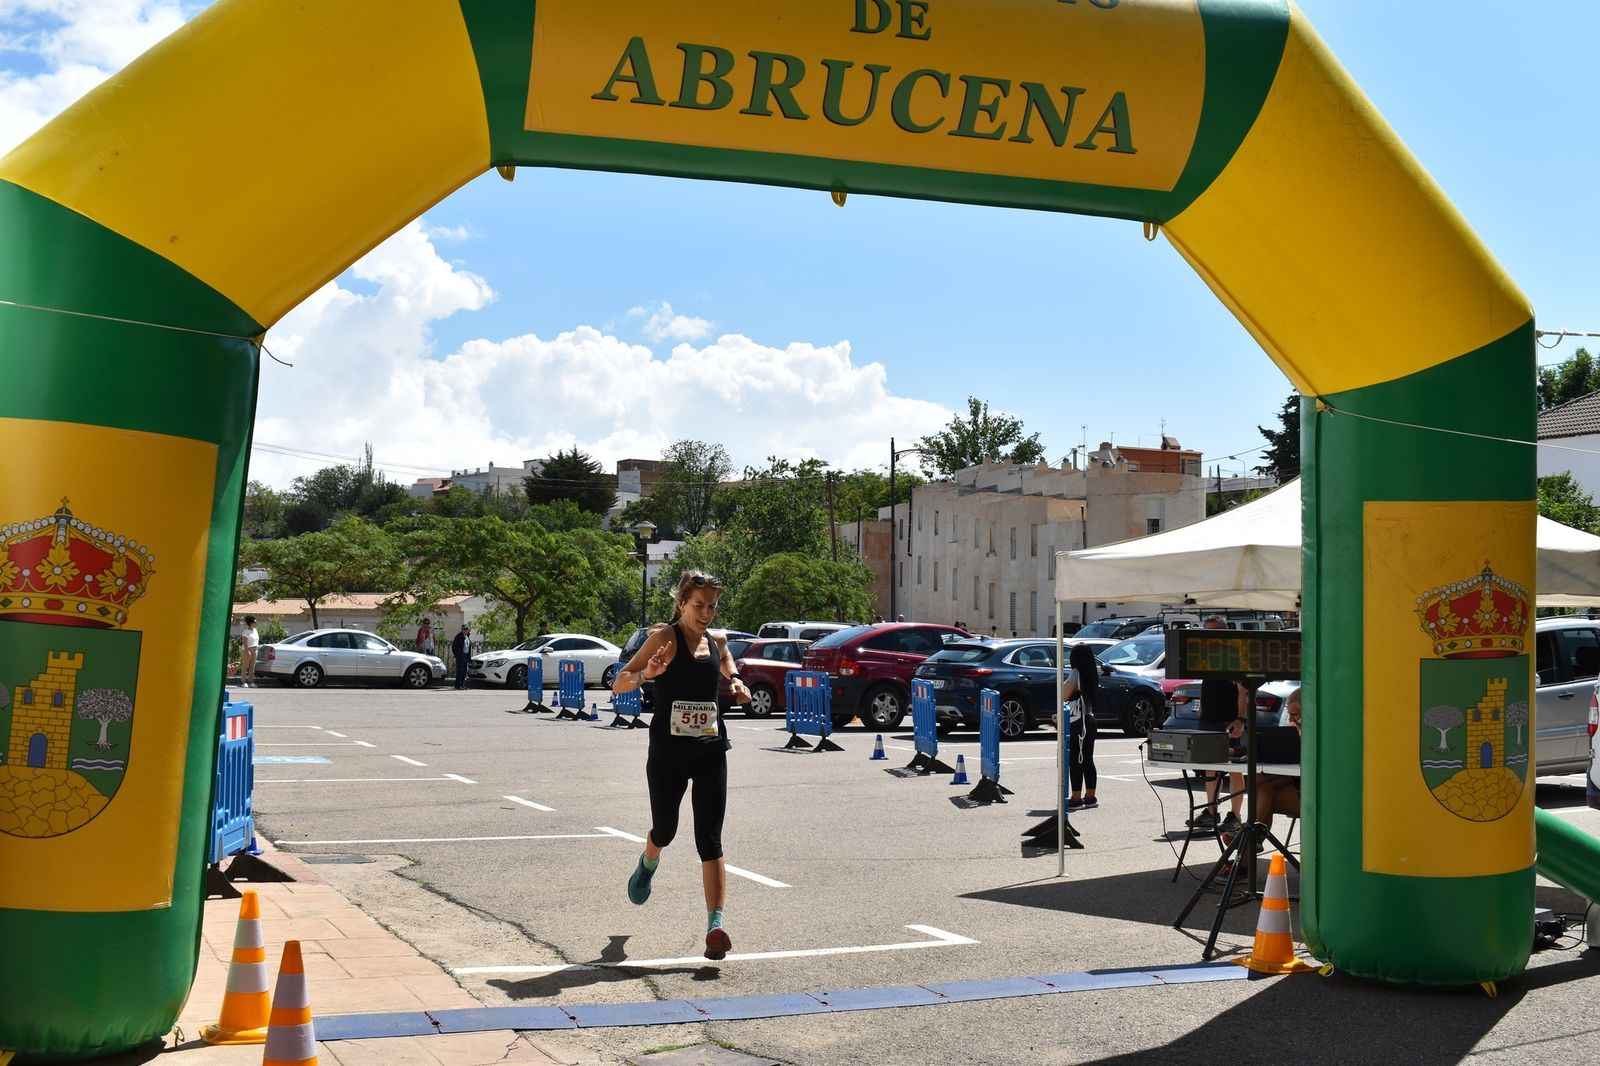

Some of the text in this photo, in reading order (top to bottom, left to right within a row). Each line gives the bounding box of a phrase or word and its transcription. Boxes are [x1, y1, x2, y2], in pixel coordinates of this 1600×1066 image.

[850, 0, 932, 41] DE
[591, 36, 1138, 155] ABRUCENA
[681, 712, 708, 724] 519
